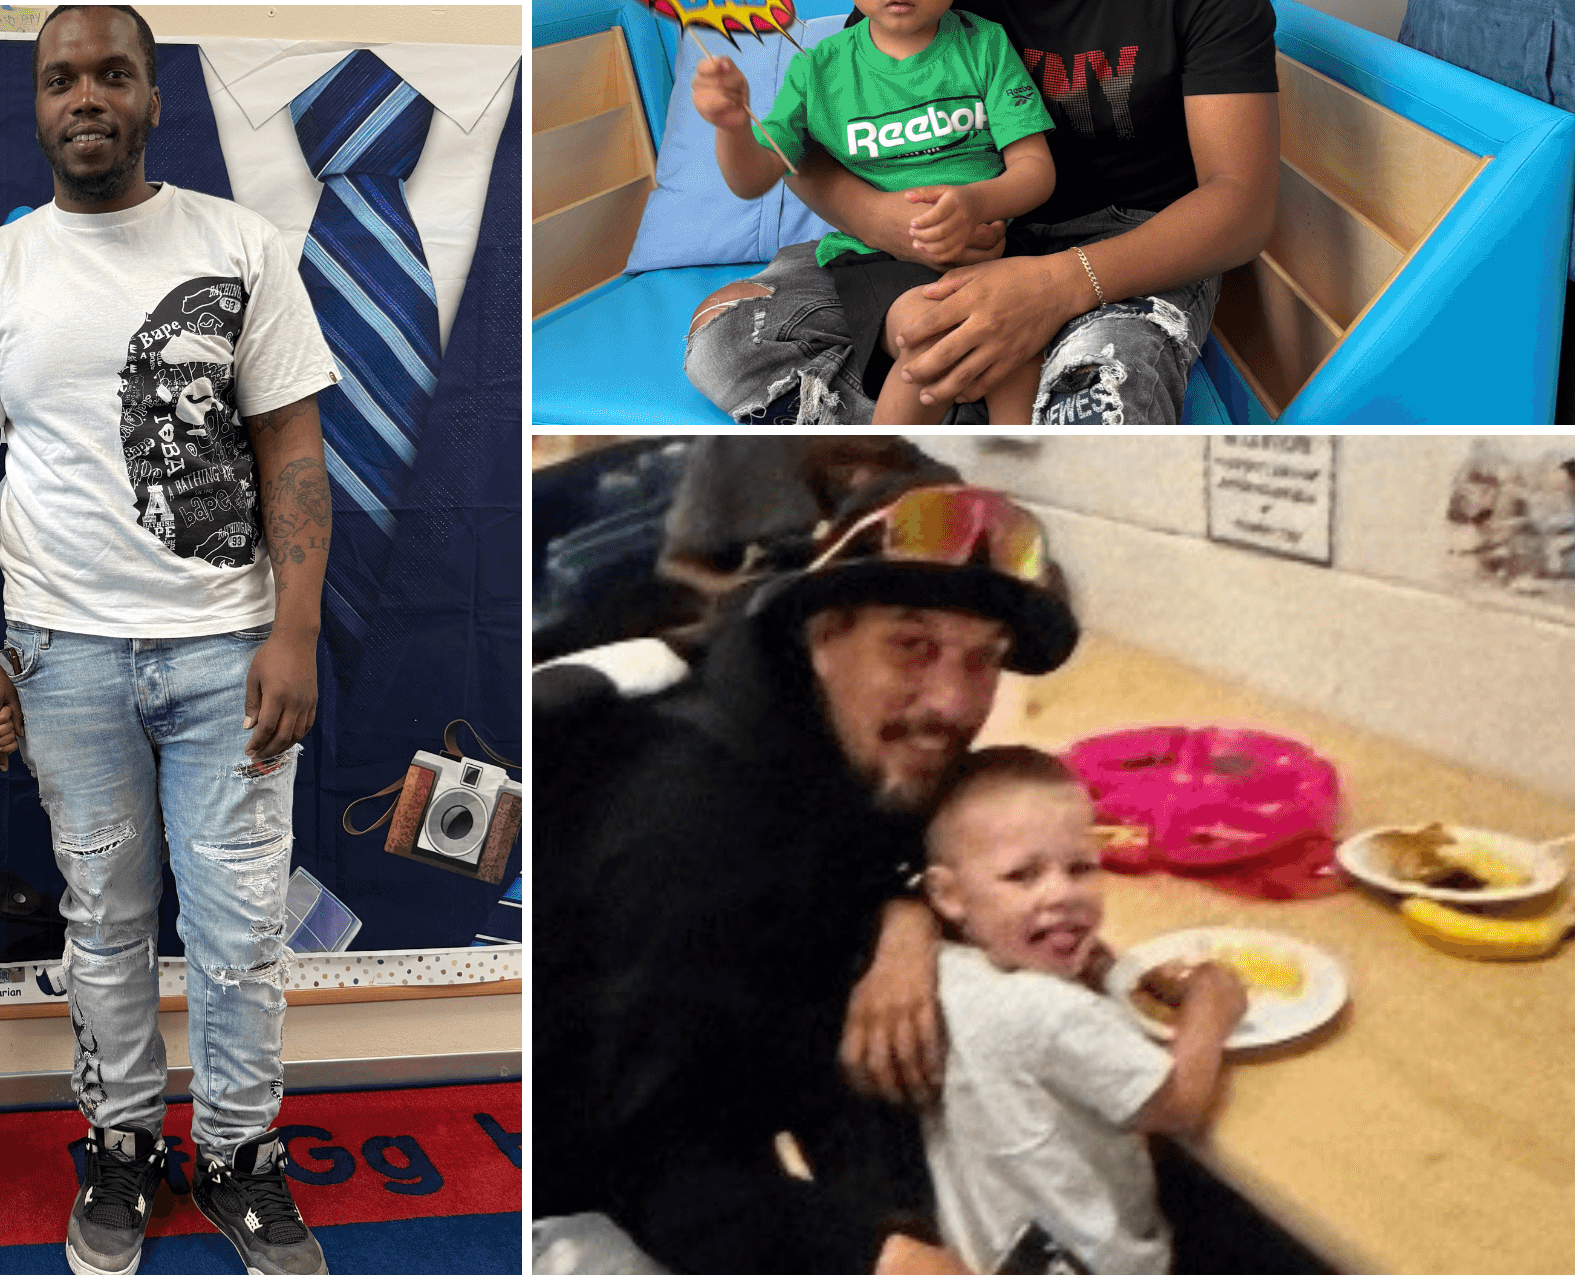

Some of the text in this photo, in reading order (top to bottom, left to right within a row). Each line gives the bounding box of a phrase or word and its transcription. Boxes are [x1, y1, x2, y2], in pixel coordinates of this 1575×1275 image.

[225, 299, 236, 311] 93
[138, 320, 181, 349] Bape
[174, 466, 220, 495] BATHING
[223, 465, 238, 482] APE
[179, 489, 232, 528] bape
[232, 536, 243, 547] 93
